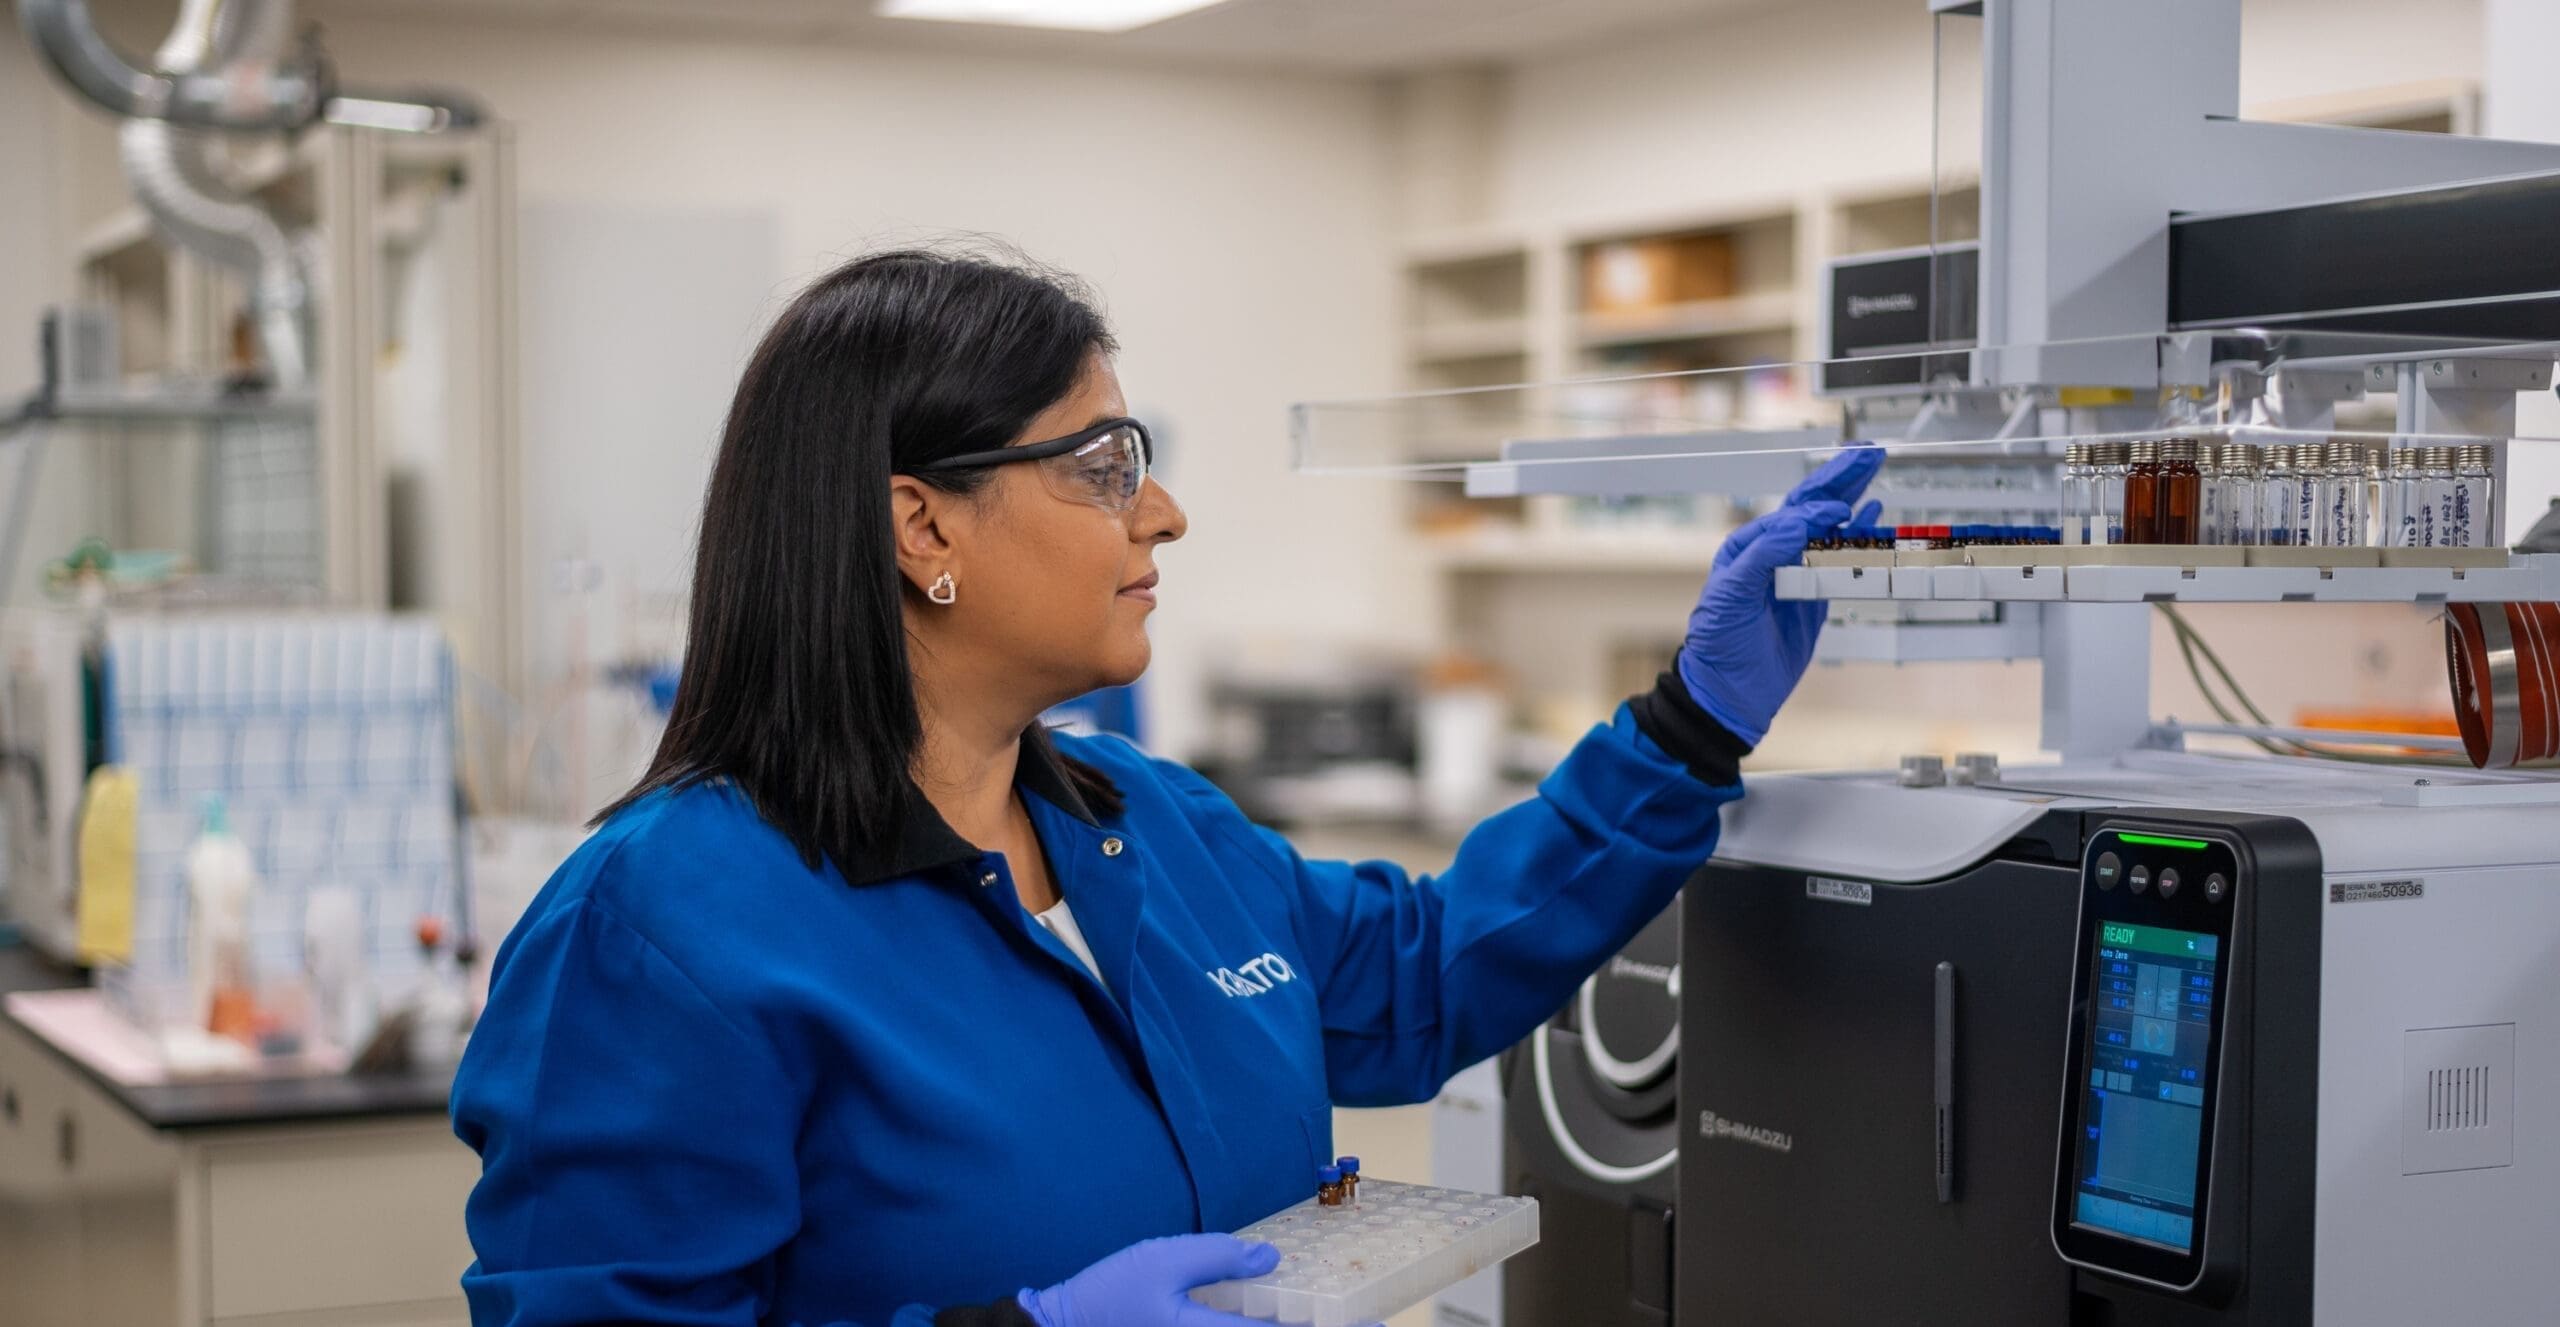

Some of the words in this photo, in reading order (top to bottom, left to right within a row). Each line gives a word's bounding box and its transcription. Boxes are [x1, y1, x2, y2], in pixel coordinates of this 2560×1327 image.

[2103, 925, 2136, 945] READY
[2100, 947, 2113, 958] Auto
[2115, 949, 2129, 960] Zero
[1715, 1117, 1793, 1152] SHIMADZU
